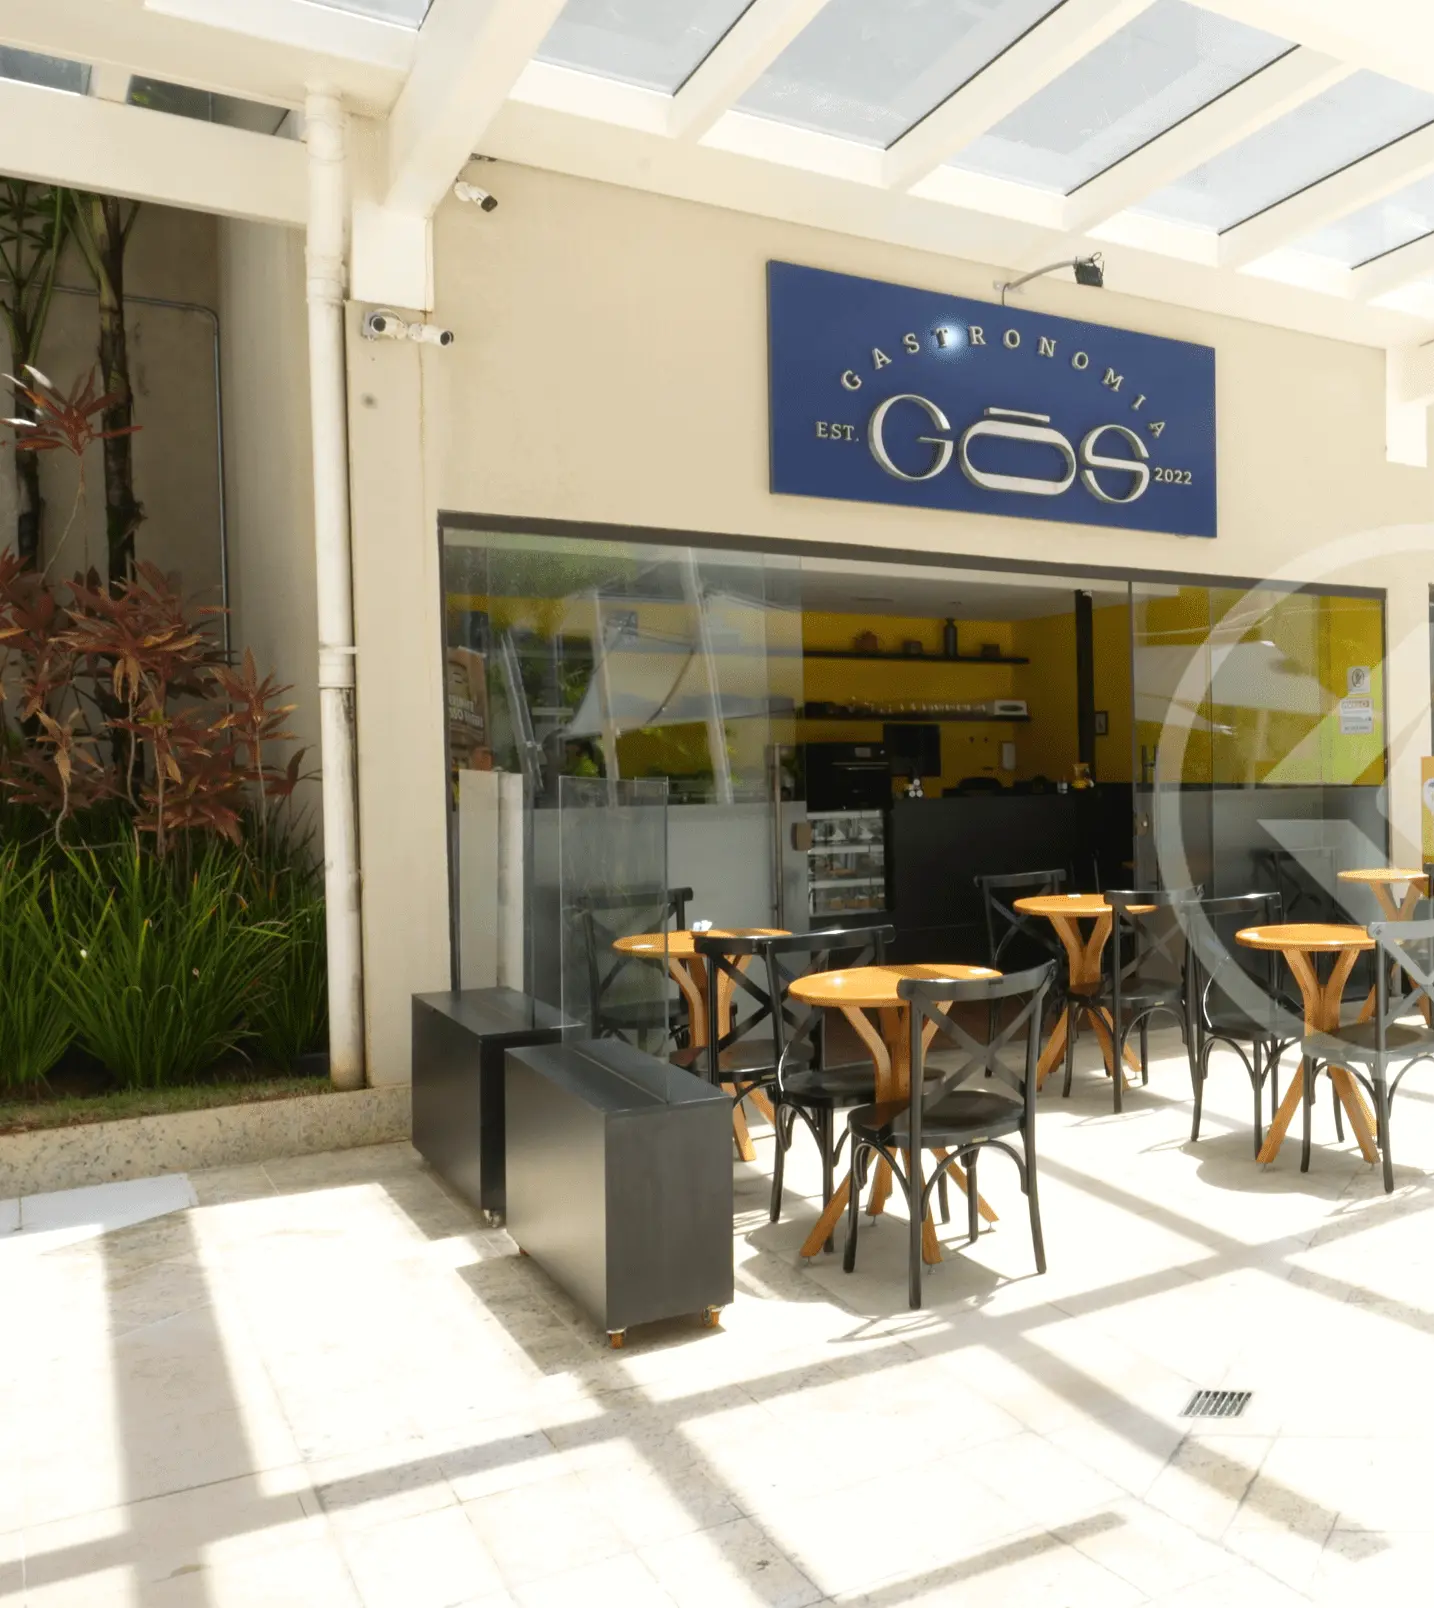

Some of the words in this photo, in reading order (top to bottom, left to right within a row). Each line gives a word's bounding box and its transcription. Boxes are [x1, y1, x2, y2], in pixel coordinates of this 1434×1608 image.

[840, 325, 1167, 438] GASTRONOMIA
[815, 420, 859, 442] EST.
[1154, 467, 1193, 486] 2022
